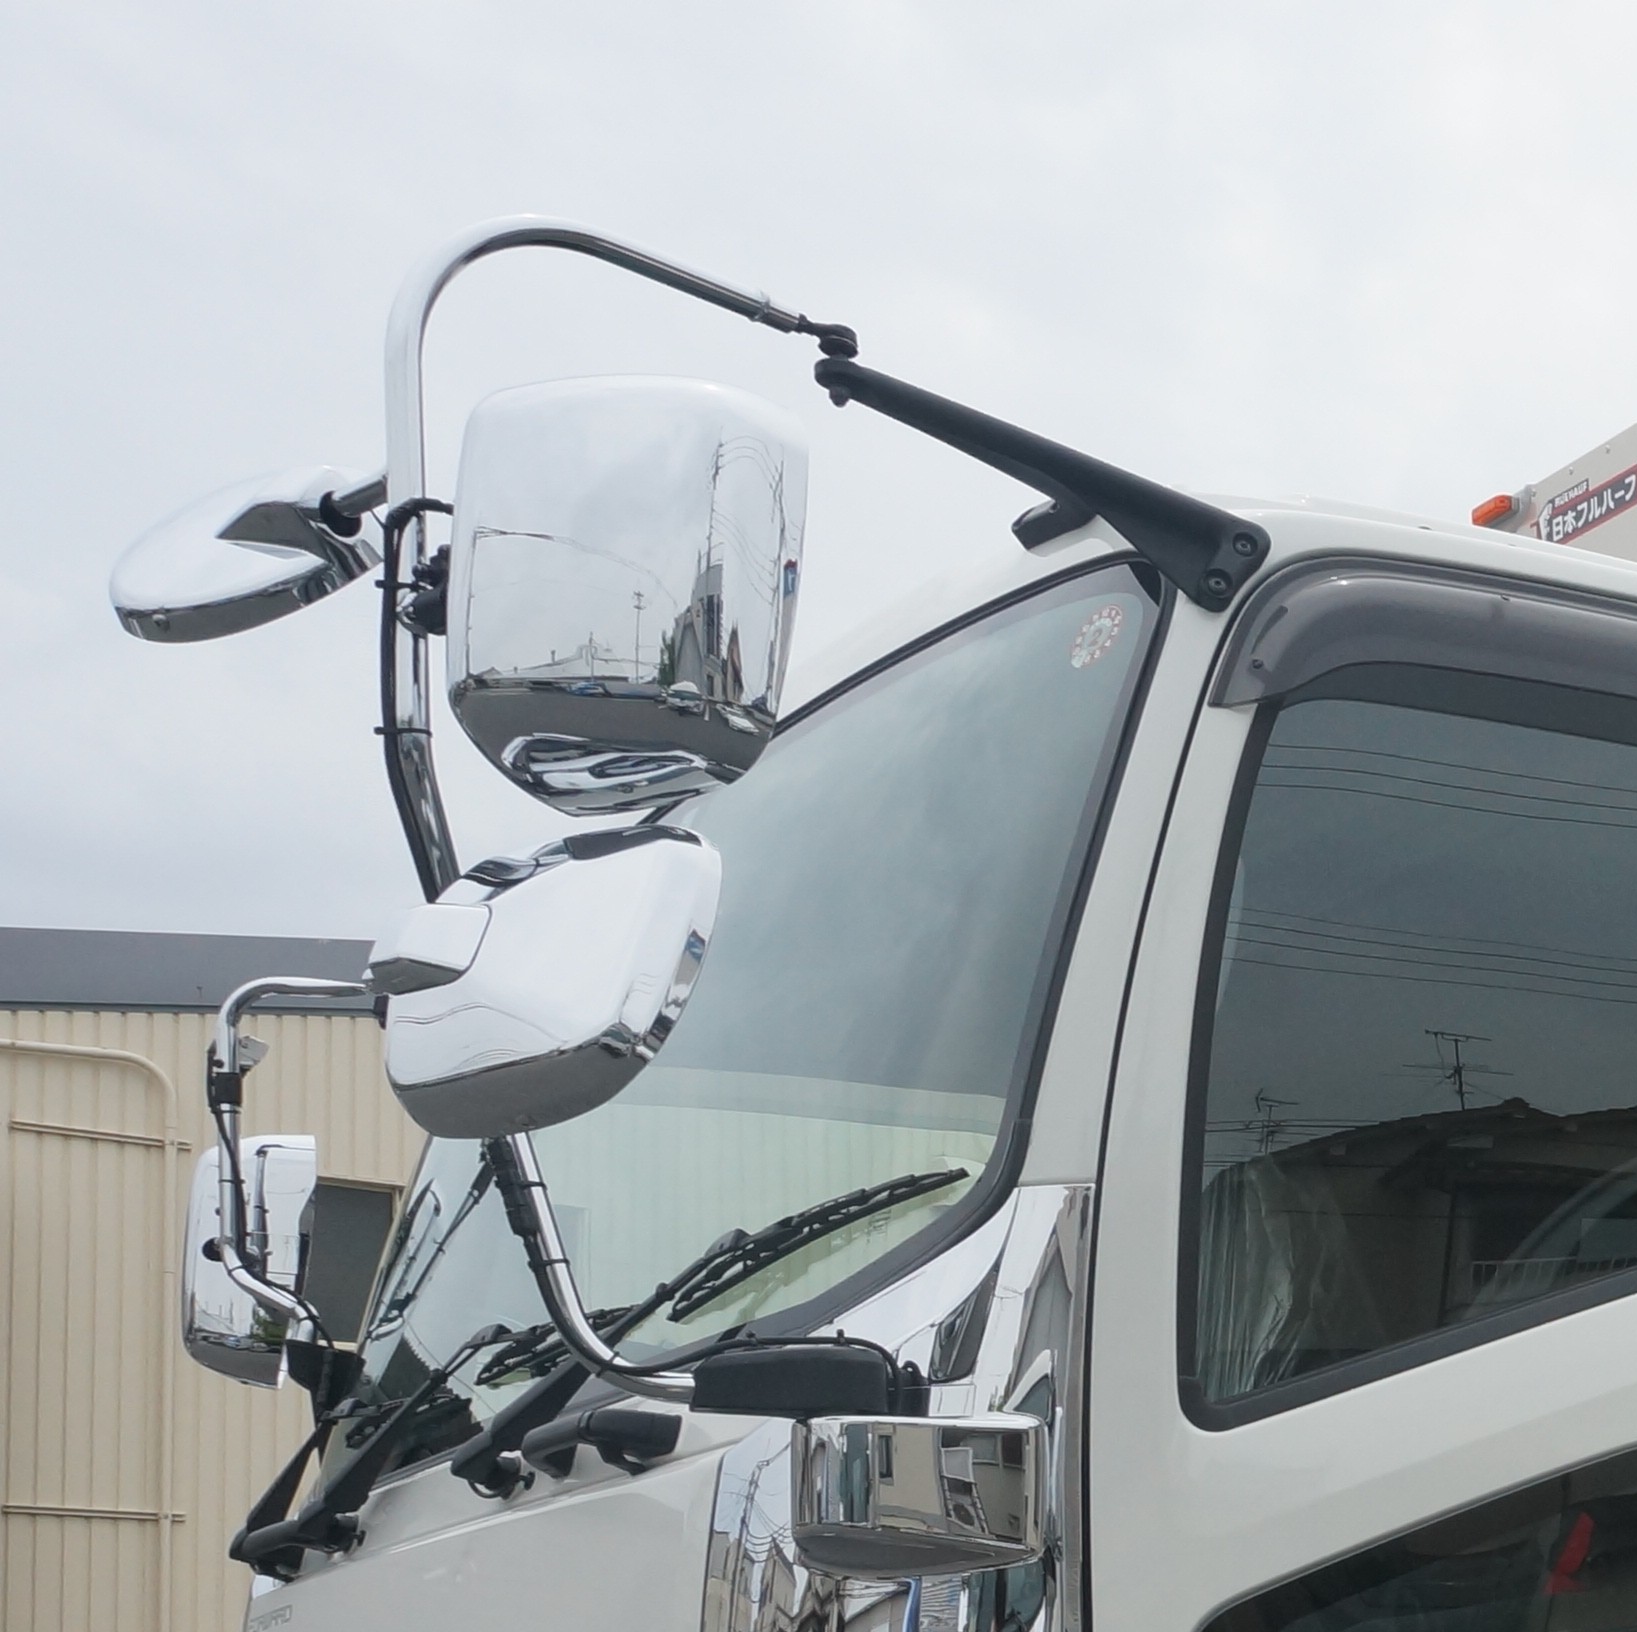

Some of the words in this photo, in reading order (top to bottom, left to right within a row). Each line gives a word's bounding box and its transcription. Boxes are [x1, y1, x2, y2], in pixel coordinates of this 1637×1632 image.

[1552, 474, 1637, 542] 日本フルハーフ
